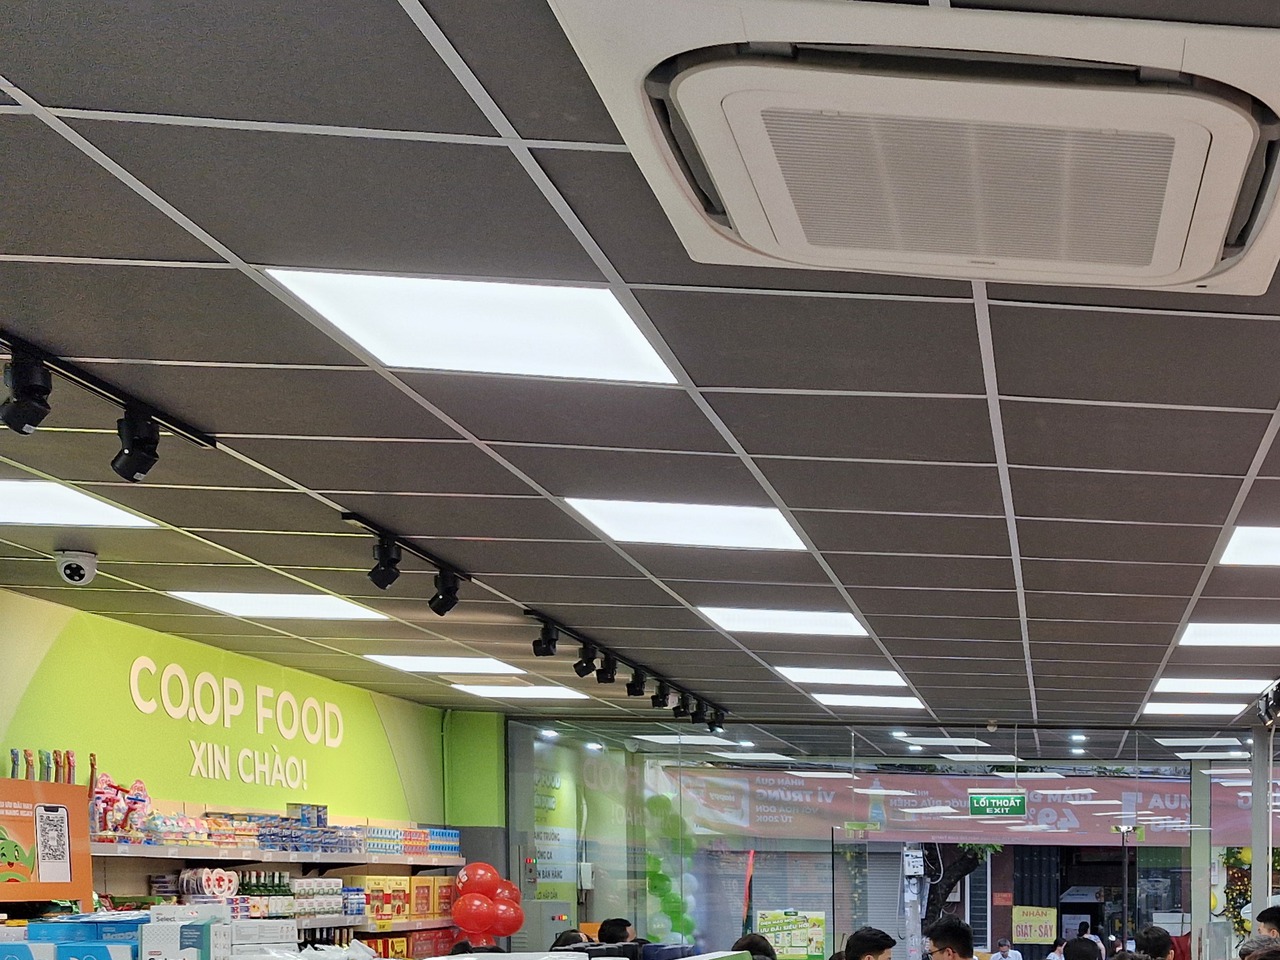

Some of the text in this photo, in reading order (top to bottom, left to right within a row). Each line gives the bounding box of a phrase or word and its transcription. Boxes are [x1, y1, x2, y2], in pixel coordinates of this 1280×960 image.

[129, 656, 345, 749] CO.OP FOOD
[189, 740, 309, 791] XIN CHÀO!
[974, 798, 1021, 807] LỐI THOÁT
